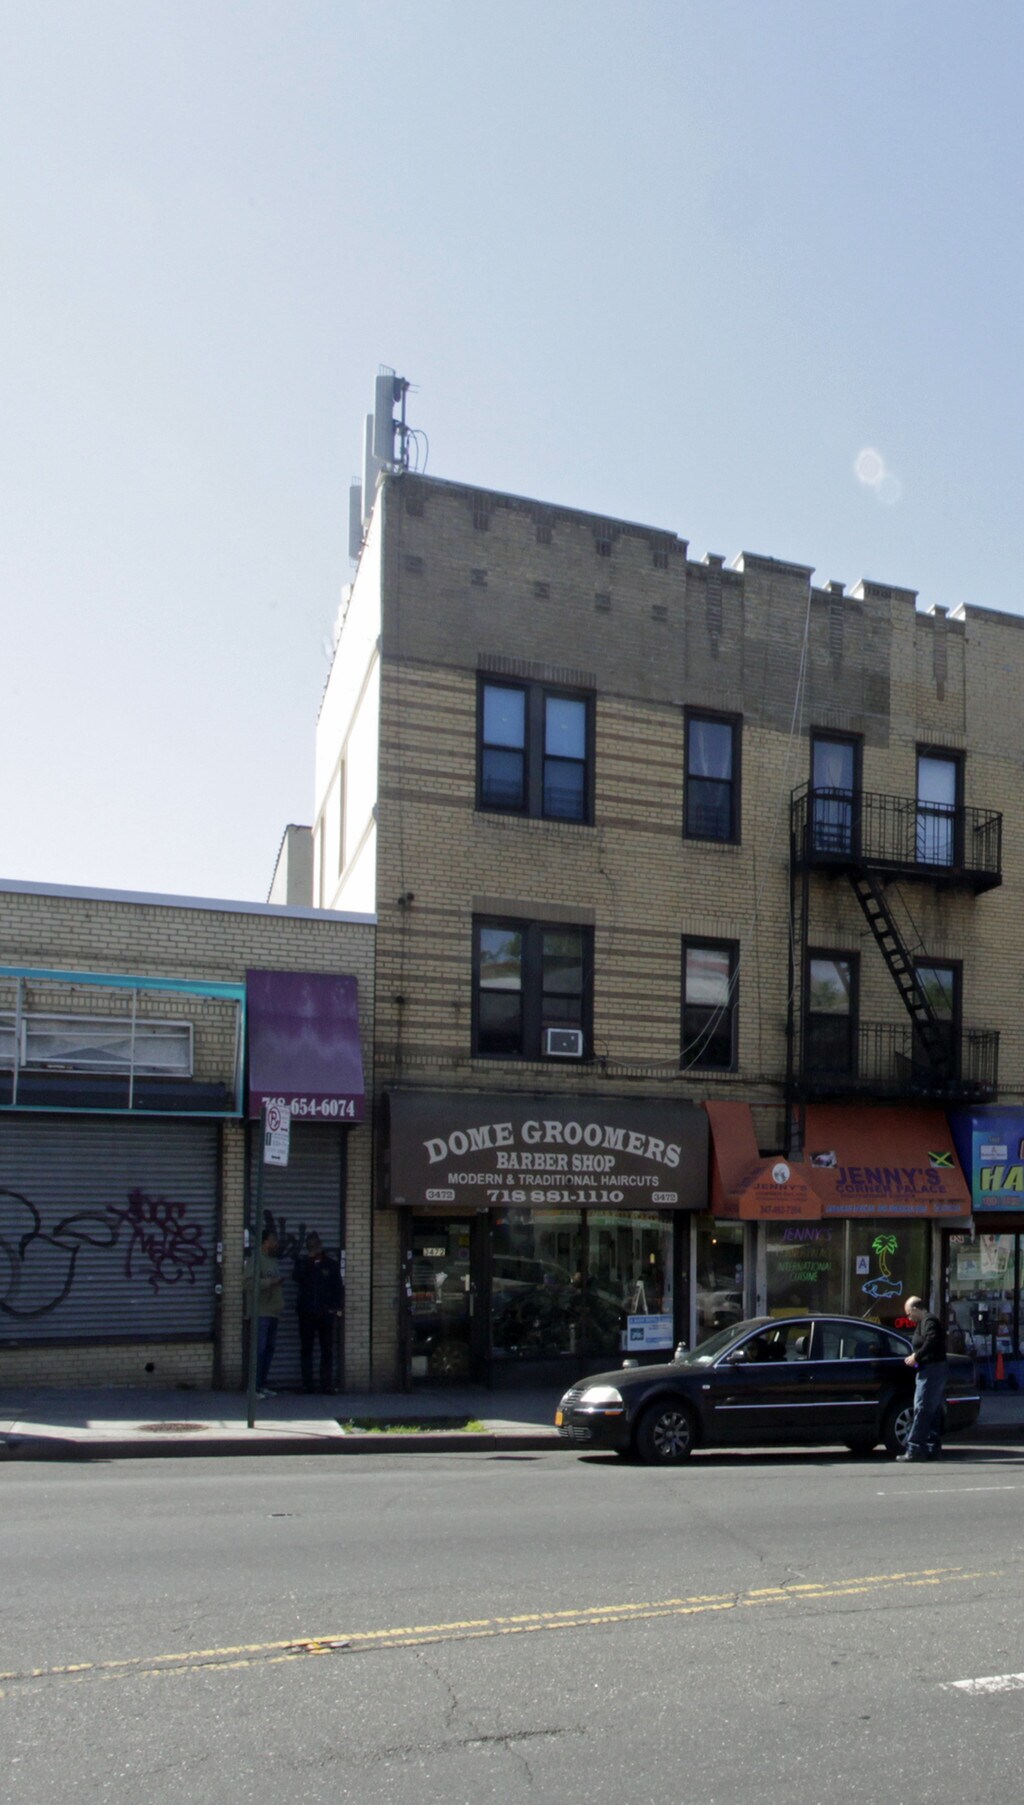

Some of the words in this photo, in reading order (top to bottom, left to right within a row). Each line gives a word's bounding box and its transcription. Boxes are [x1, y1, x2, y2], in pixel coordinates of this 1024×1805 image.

[423, 1122, 514, 1165] DOME
[521, 1120, 682, 1168] GROOMERS
[496, 1152, 568, 1171] BARBER
[571, 1154, 616, 1172] SHOP
[448, 1173, 503, 1185] MODERN
[506, 1174, 515, 1185] &
[518, 1174, 598, 1186] TRADITIONAL
[601, 1175, 659, 1187] HAIRCUTS
[836, 1166, 941, 1186] JENNY'S
[428, 1190, 453, 1199] 3472
[487, 1190, 526, 1202] 718
[530, 1190, 624, 1202] 881-1110
[654, 1193, 676, 1202] 3472
[783, 1227, 832, 1242] JENNY'S
[858, 1259, 867, 1268] A
